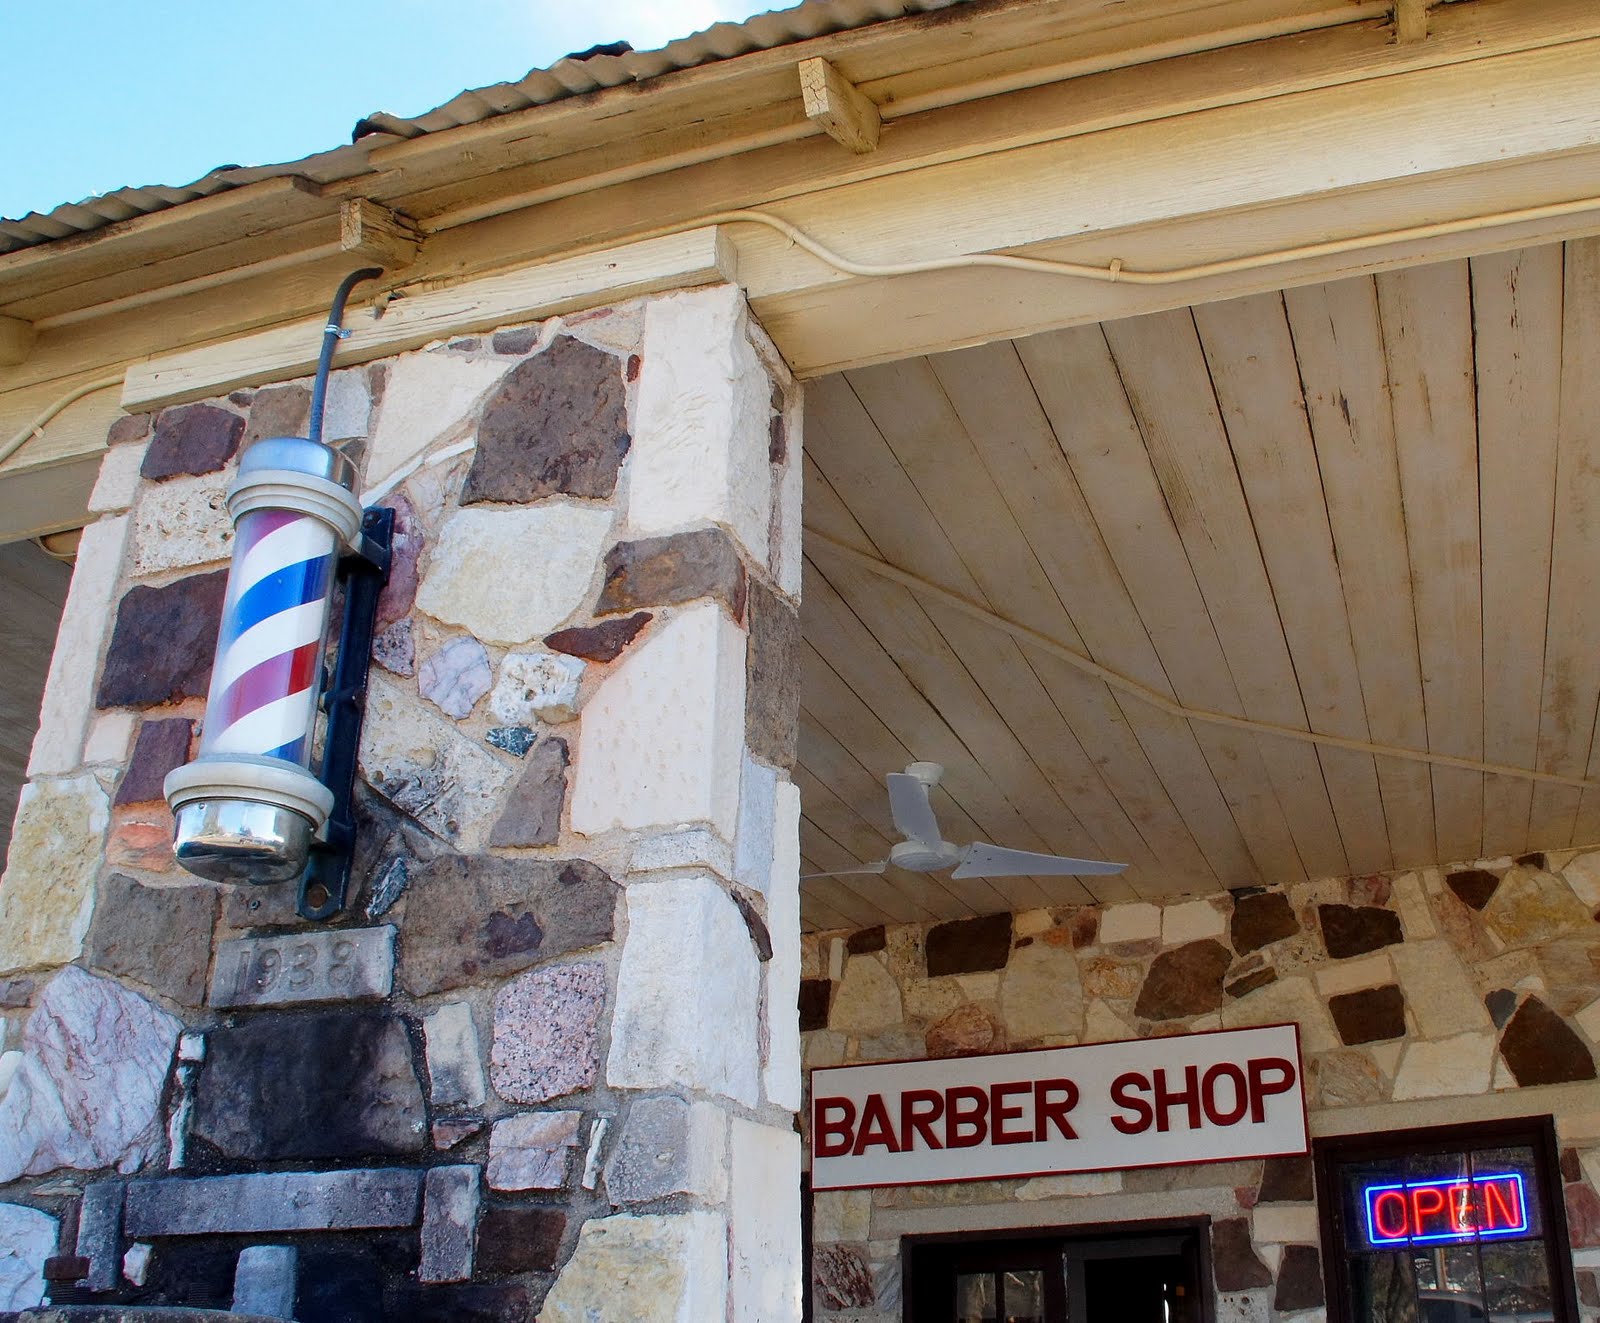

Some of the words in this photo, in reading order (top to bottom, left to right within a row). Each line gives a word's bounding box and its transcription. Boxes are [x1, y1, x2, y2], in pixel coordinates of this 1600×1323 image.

[234, 940, 355, 996] 1938
[814, 1077, 1080, 1159] BARBER
[1109, 1056, 1297, 1135] SHOP
[1373, 1179, 1522, 1239] OPEN
